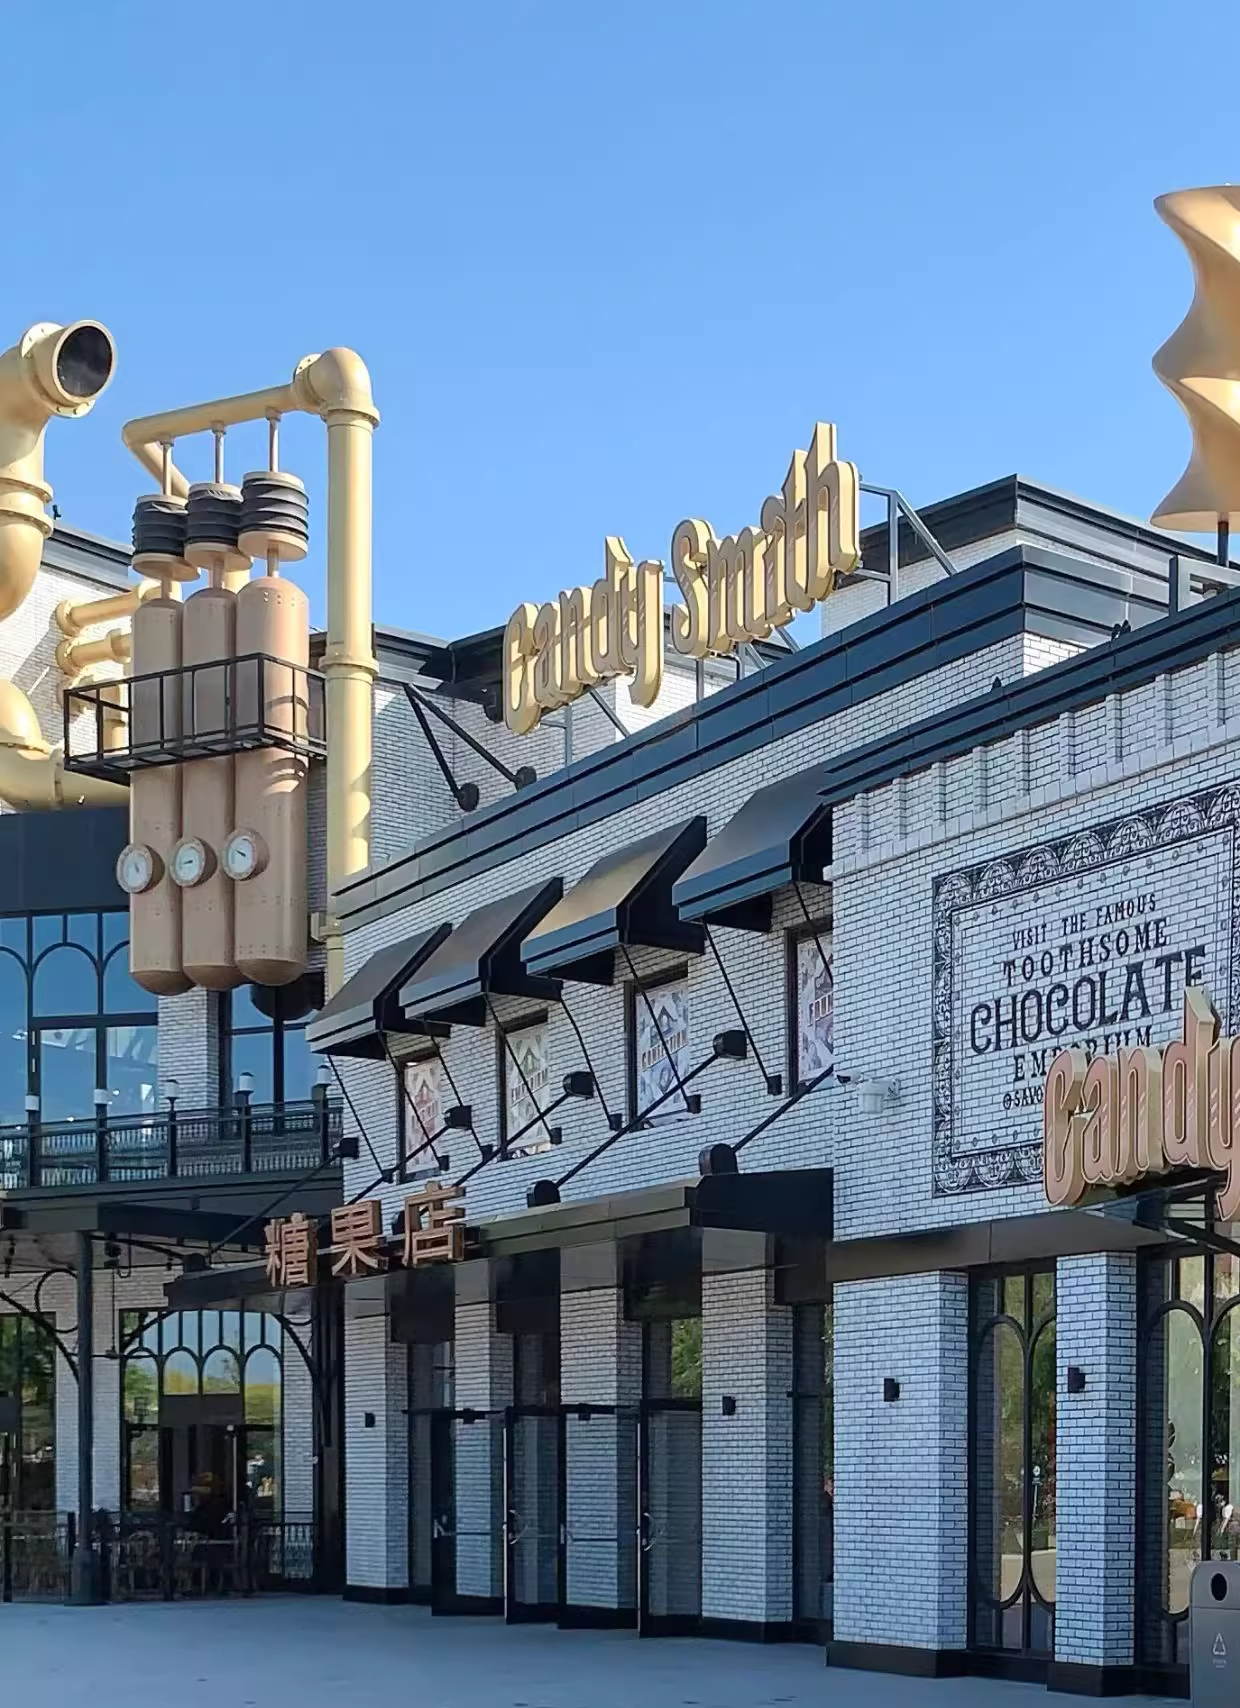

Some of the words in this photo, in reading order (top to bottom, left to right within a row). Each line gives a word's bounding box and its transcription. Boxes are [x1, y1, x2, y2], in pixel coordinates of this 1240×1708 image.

[503, 536, 664, 736] Candy
[671, 421, 861, 659] Smith
[1003, 918, 1168, 987] TOOTHSOME
[1012, 923, 1047, 951] VISIT
[1062, 911, 1087, 937] THE
[1096, 893, 1157, 925] FAMOUS
[970, 945, 1206, 1054] CHOCOLATE
[264, 1180, 467, 1287] 糖果店
